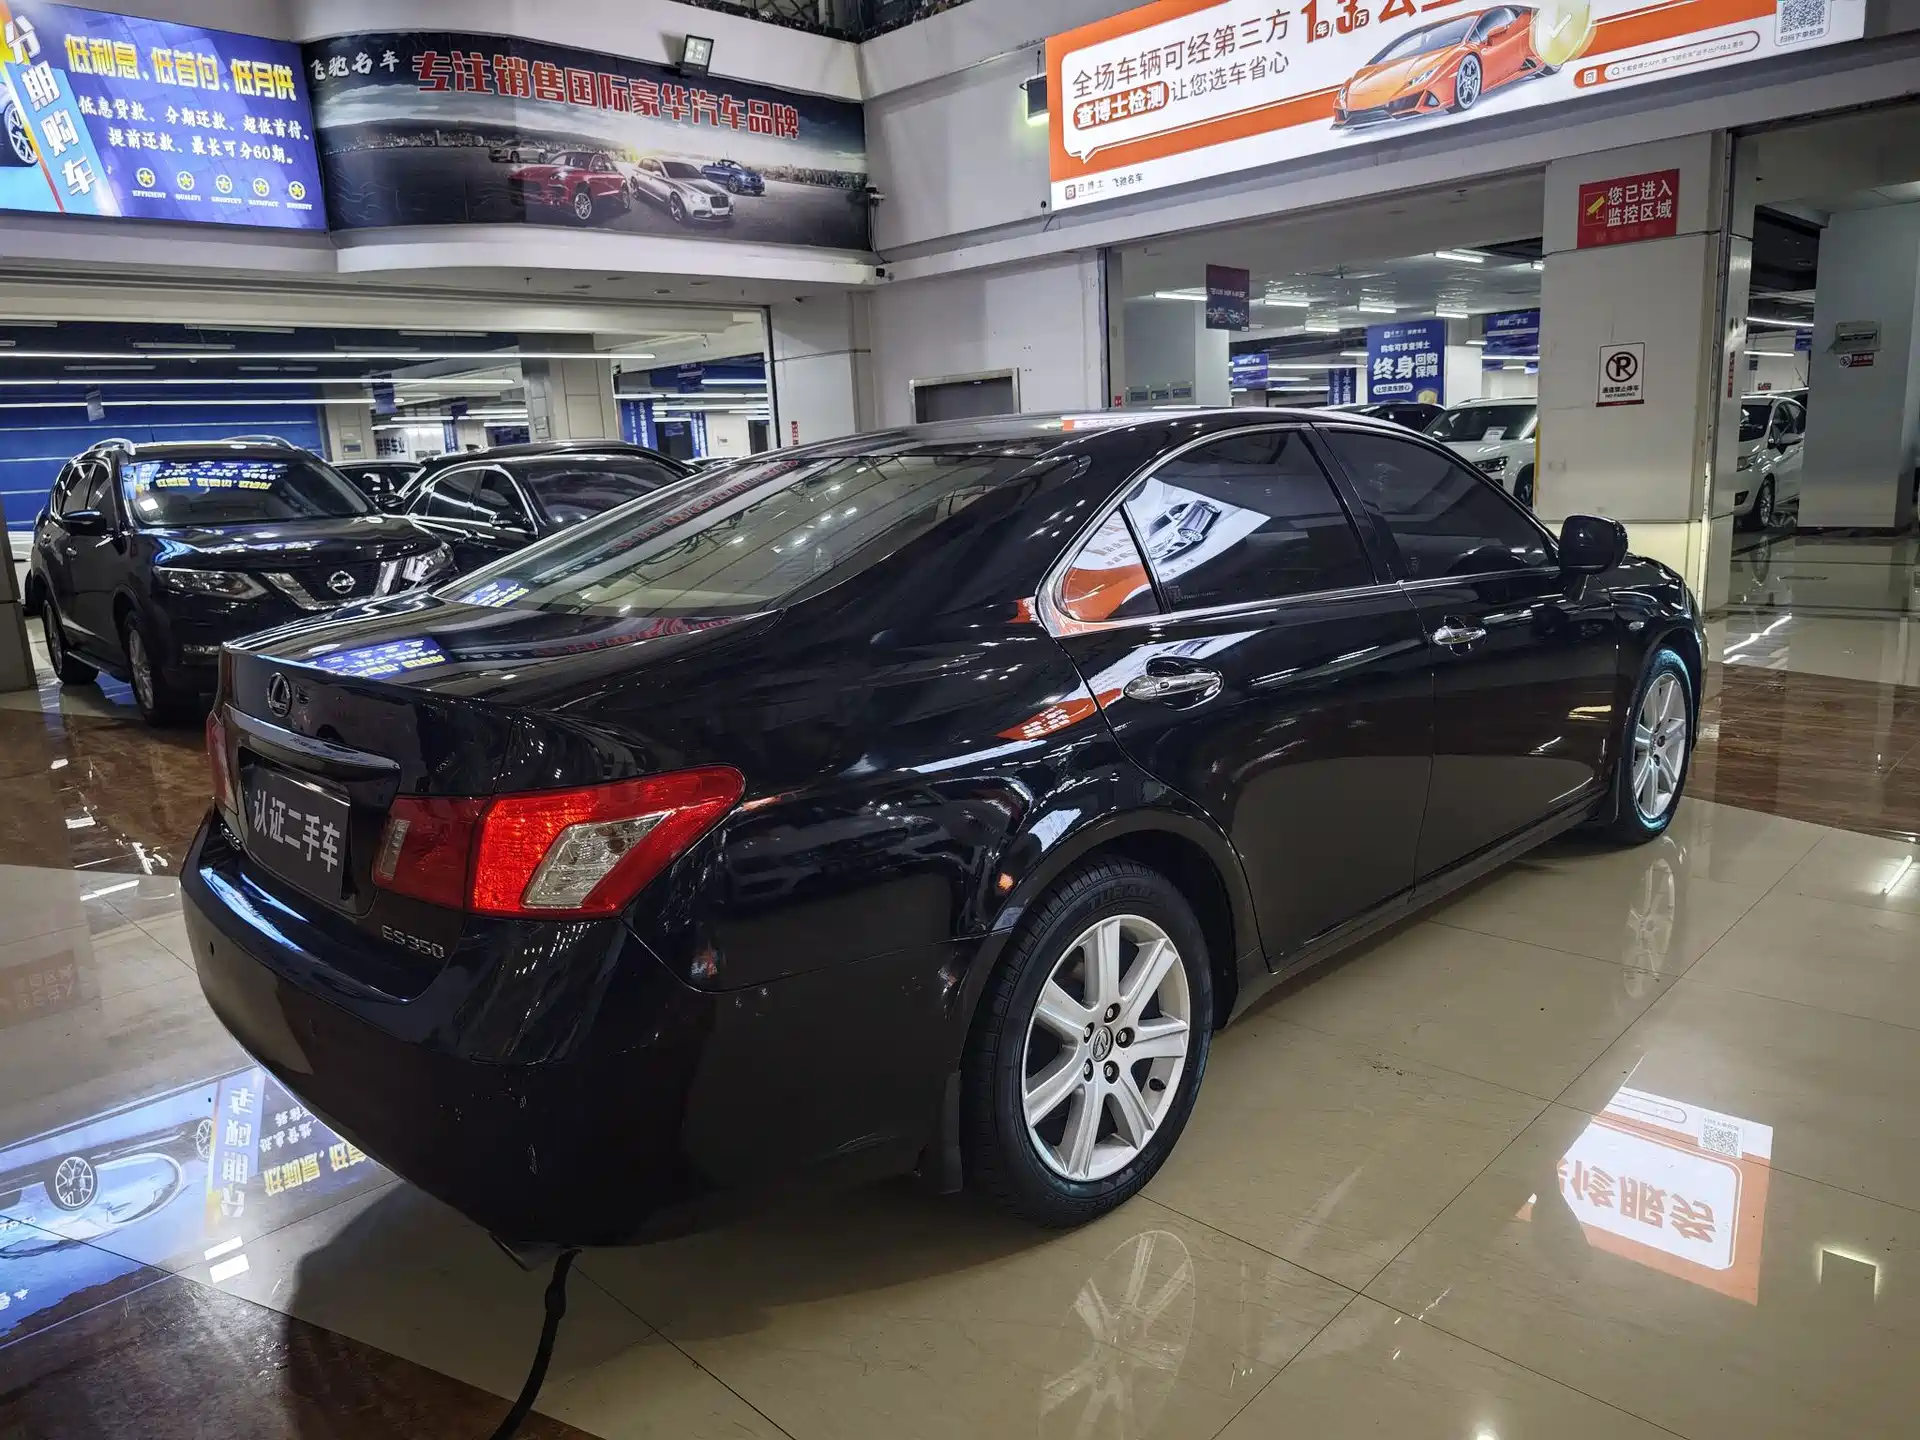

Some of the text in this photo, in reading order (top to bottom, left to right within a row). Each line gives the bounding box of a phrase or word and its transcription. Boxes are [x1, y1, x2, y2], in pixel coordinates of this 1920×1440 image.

[310, 50, 400, 81] 飞驰名车
[1073, 9, 1291, 99] 全场车辆可经第三方
[1076, 51, 1290, 128] 查博士检测 让您选车省心
[5, 14, 96, 196] 分期购车
[412, 50, 799, 140] 专注销售国际豪华汽车品牌
[1607, 179, 1672, 205] 您已进入
[1607, 199, 1672, 227] 监控区域
[1373, 352, 1438, 380] 终身 回购
[253, 789, 341, 872] 认证二手车
